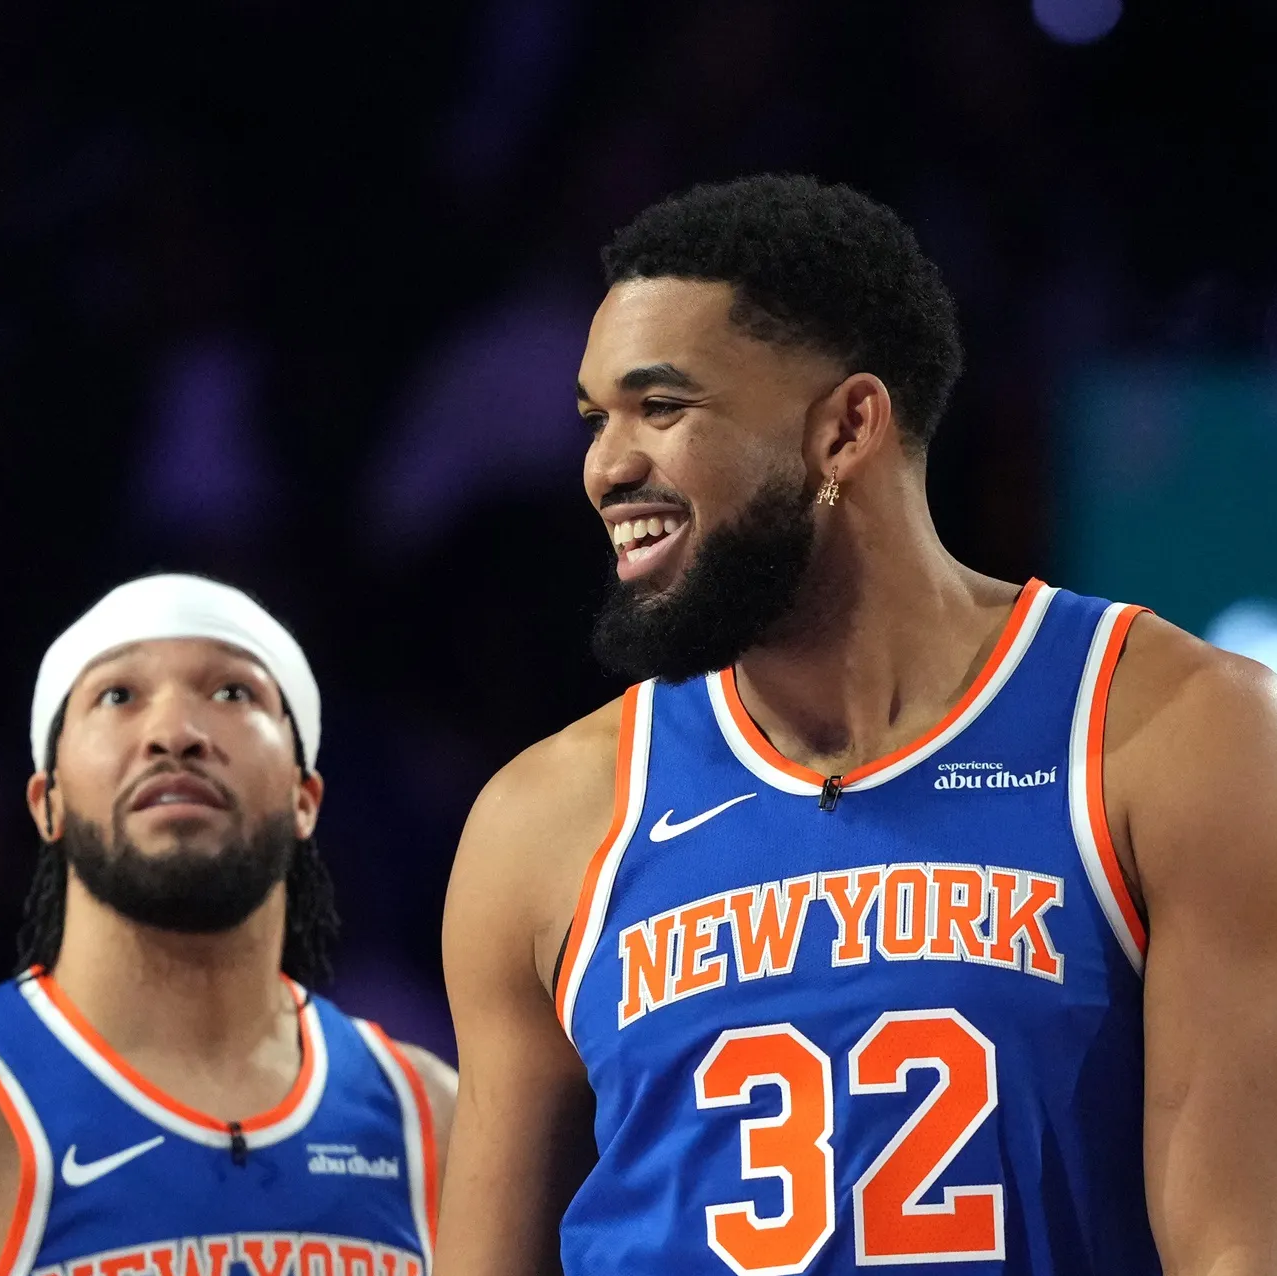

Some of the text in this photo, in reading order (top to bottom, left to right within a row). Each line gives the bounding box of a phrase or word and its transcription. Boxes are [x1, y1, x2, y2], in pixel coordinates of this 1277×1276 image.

[938, 761, 1003, 772] experience
[934, 771, 982, 790] abu
[618, 862, 1064, 1030] NEW YORK
